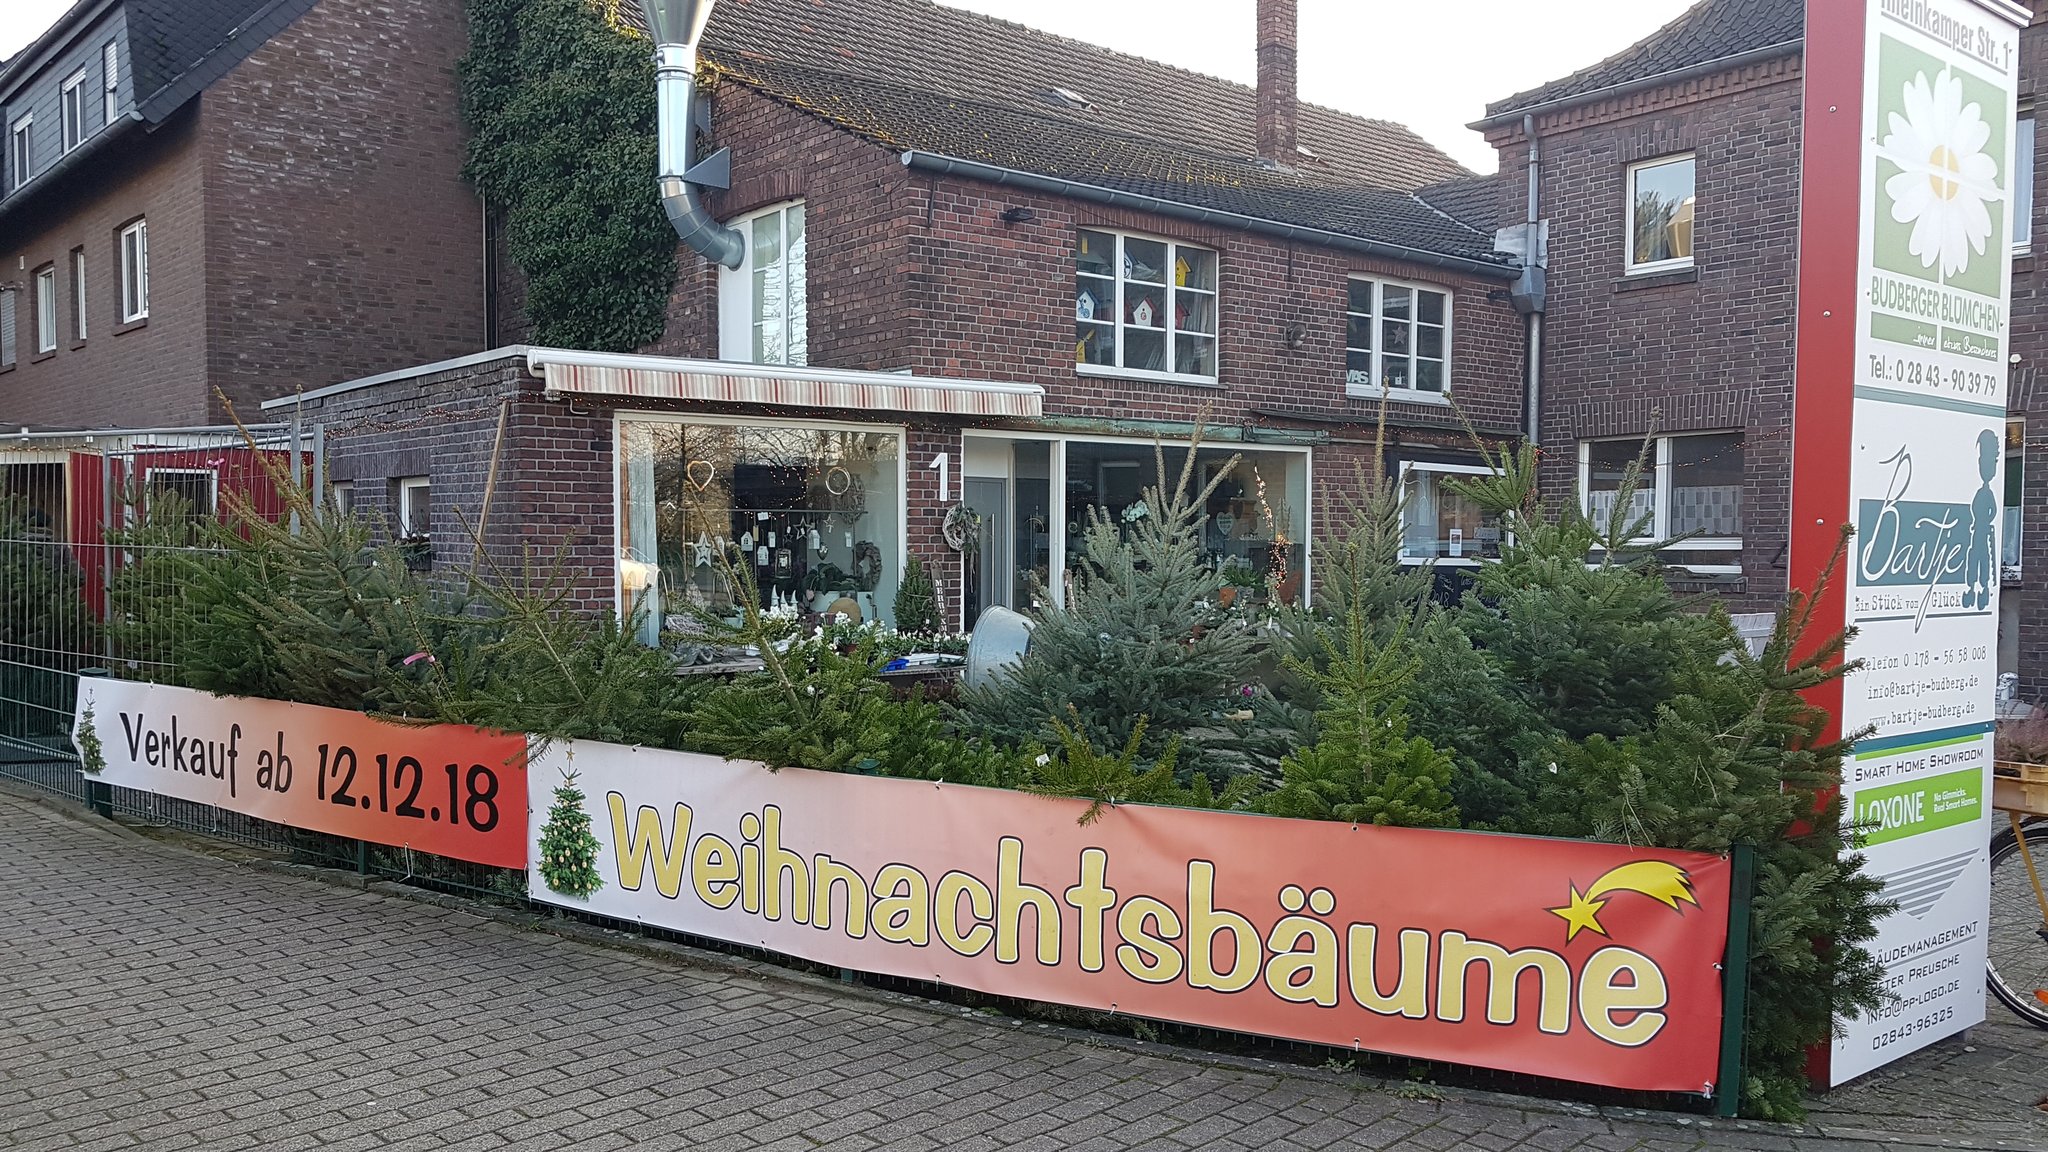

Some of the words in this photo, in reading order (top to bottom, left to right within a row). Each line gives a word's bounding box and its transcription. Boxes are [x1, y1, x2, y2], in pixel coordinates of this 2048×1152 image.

[1977, 26, 1998, 65] Str.
[2003, 41, 2009, 69] 1
[1871, 276, 1939, 319] BUDBERGER
[1941, 293, 2000, 333] BLÜMCHEN
[1869, 354, 1893, 380] Tel.:
[1896, 359, 1904, 382] 0
[1907, 361, 1922, 385] 28
[1925, 365, 1940, 387] 43
[1951, 369, 1965, 392] 90
[1968, 371, 1981, 394] 39
[1984, 375, 1996, 397] 79
[929, 452, 949, 501] 1
[1861, 443, 1964, 633] Bartje
[1872, 594, 1903, 611] Stück
[1905, 600, 1919, 609] von
[1931, 591, 1961, 608] Glück
[1903, 653, 1909, 667] 0
[1914, 650, 1930, 668] 178
[1943, 648, 1954, 665] 56
[1958, 647, 1968, 663] 58
[1971, 645, 1987, 661] 008
[1867, 674, 1979, 700] info@bartje-budberg.de
[118, 711, 243, 799] Verkauf
[256, 730, 294, 795] ab
[316, 742, 500, 834] 12.12.18
[1859, 791, 1925, 836] LOXONE
[1933, 792, 1943, 803] No
[1933, 802, 1946, 813] Real
[606, 790, 1669, 1048] Weihnachtsbäume
[1862, 920, 1979, 970] BÄUDEMANAGEMENT
[1908, 953, 1960, 983] PREUSCHE
[1872, 1005, 1954, 1051] 02843-96325
